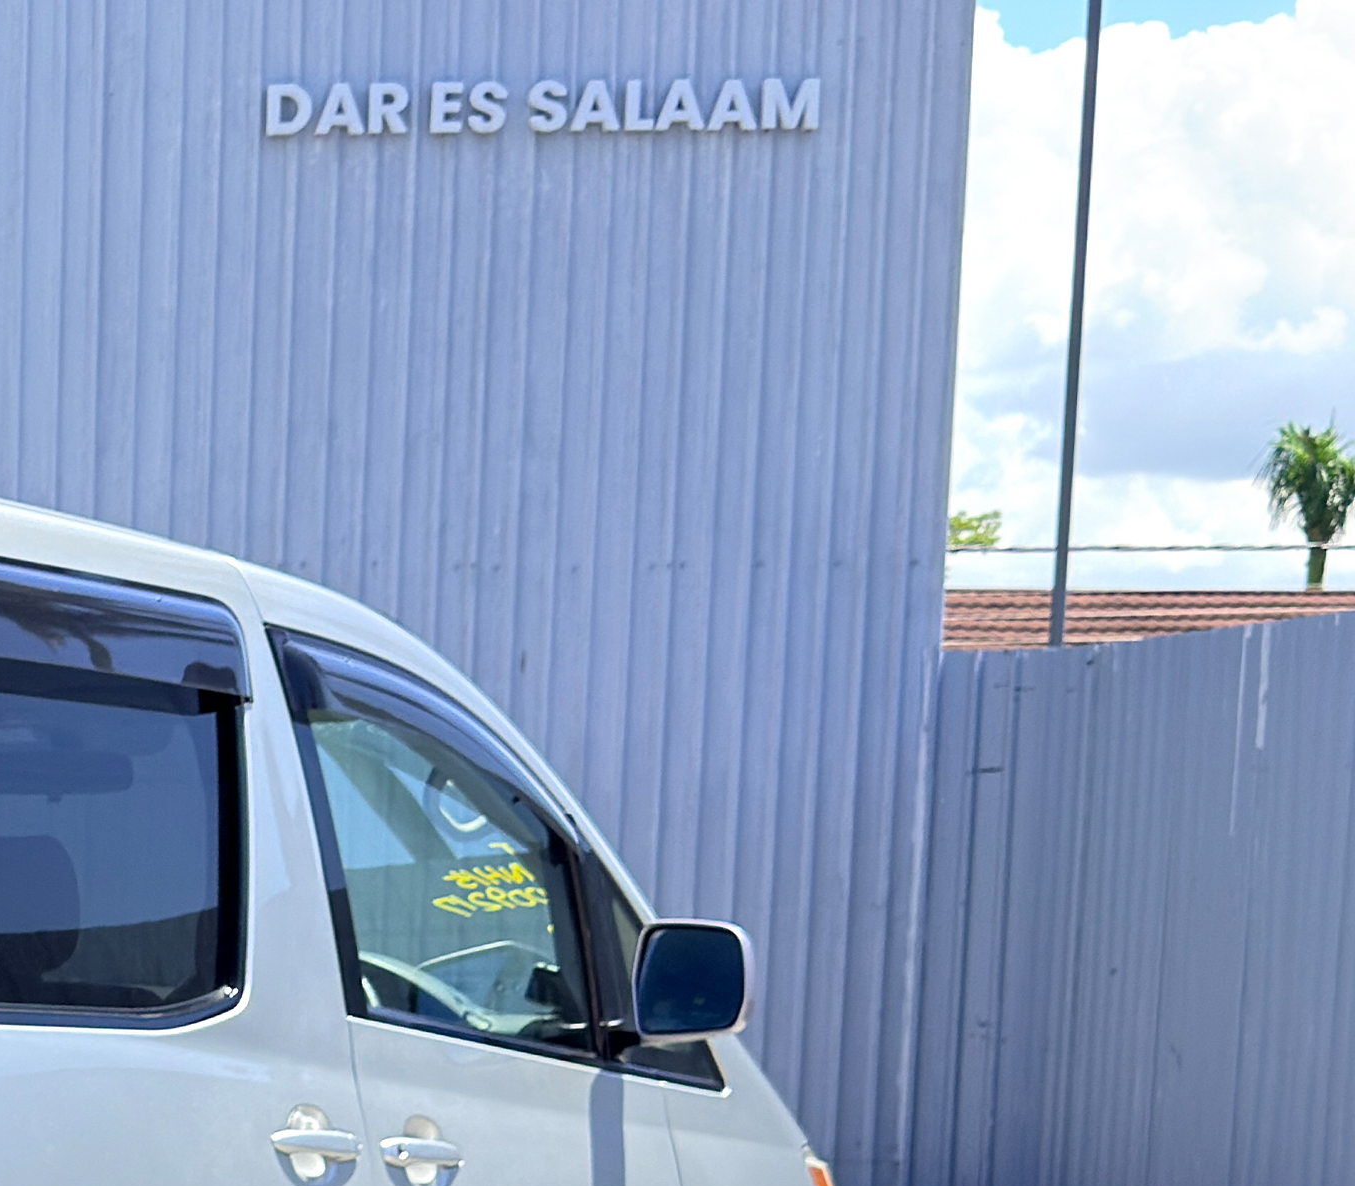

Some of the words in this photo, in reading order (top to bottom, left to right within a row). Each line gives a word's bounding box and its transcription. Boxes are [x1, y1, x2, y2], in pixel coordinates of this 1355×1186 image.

[265, 82, 410, 137] DAR
[429, 81, 509, 135] ES
[527, 77, 822, 134] SALAAM
